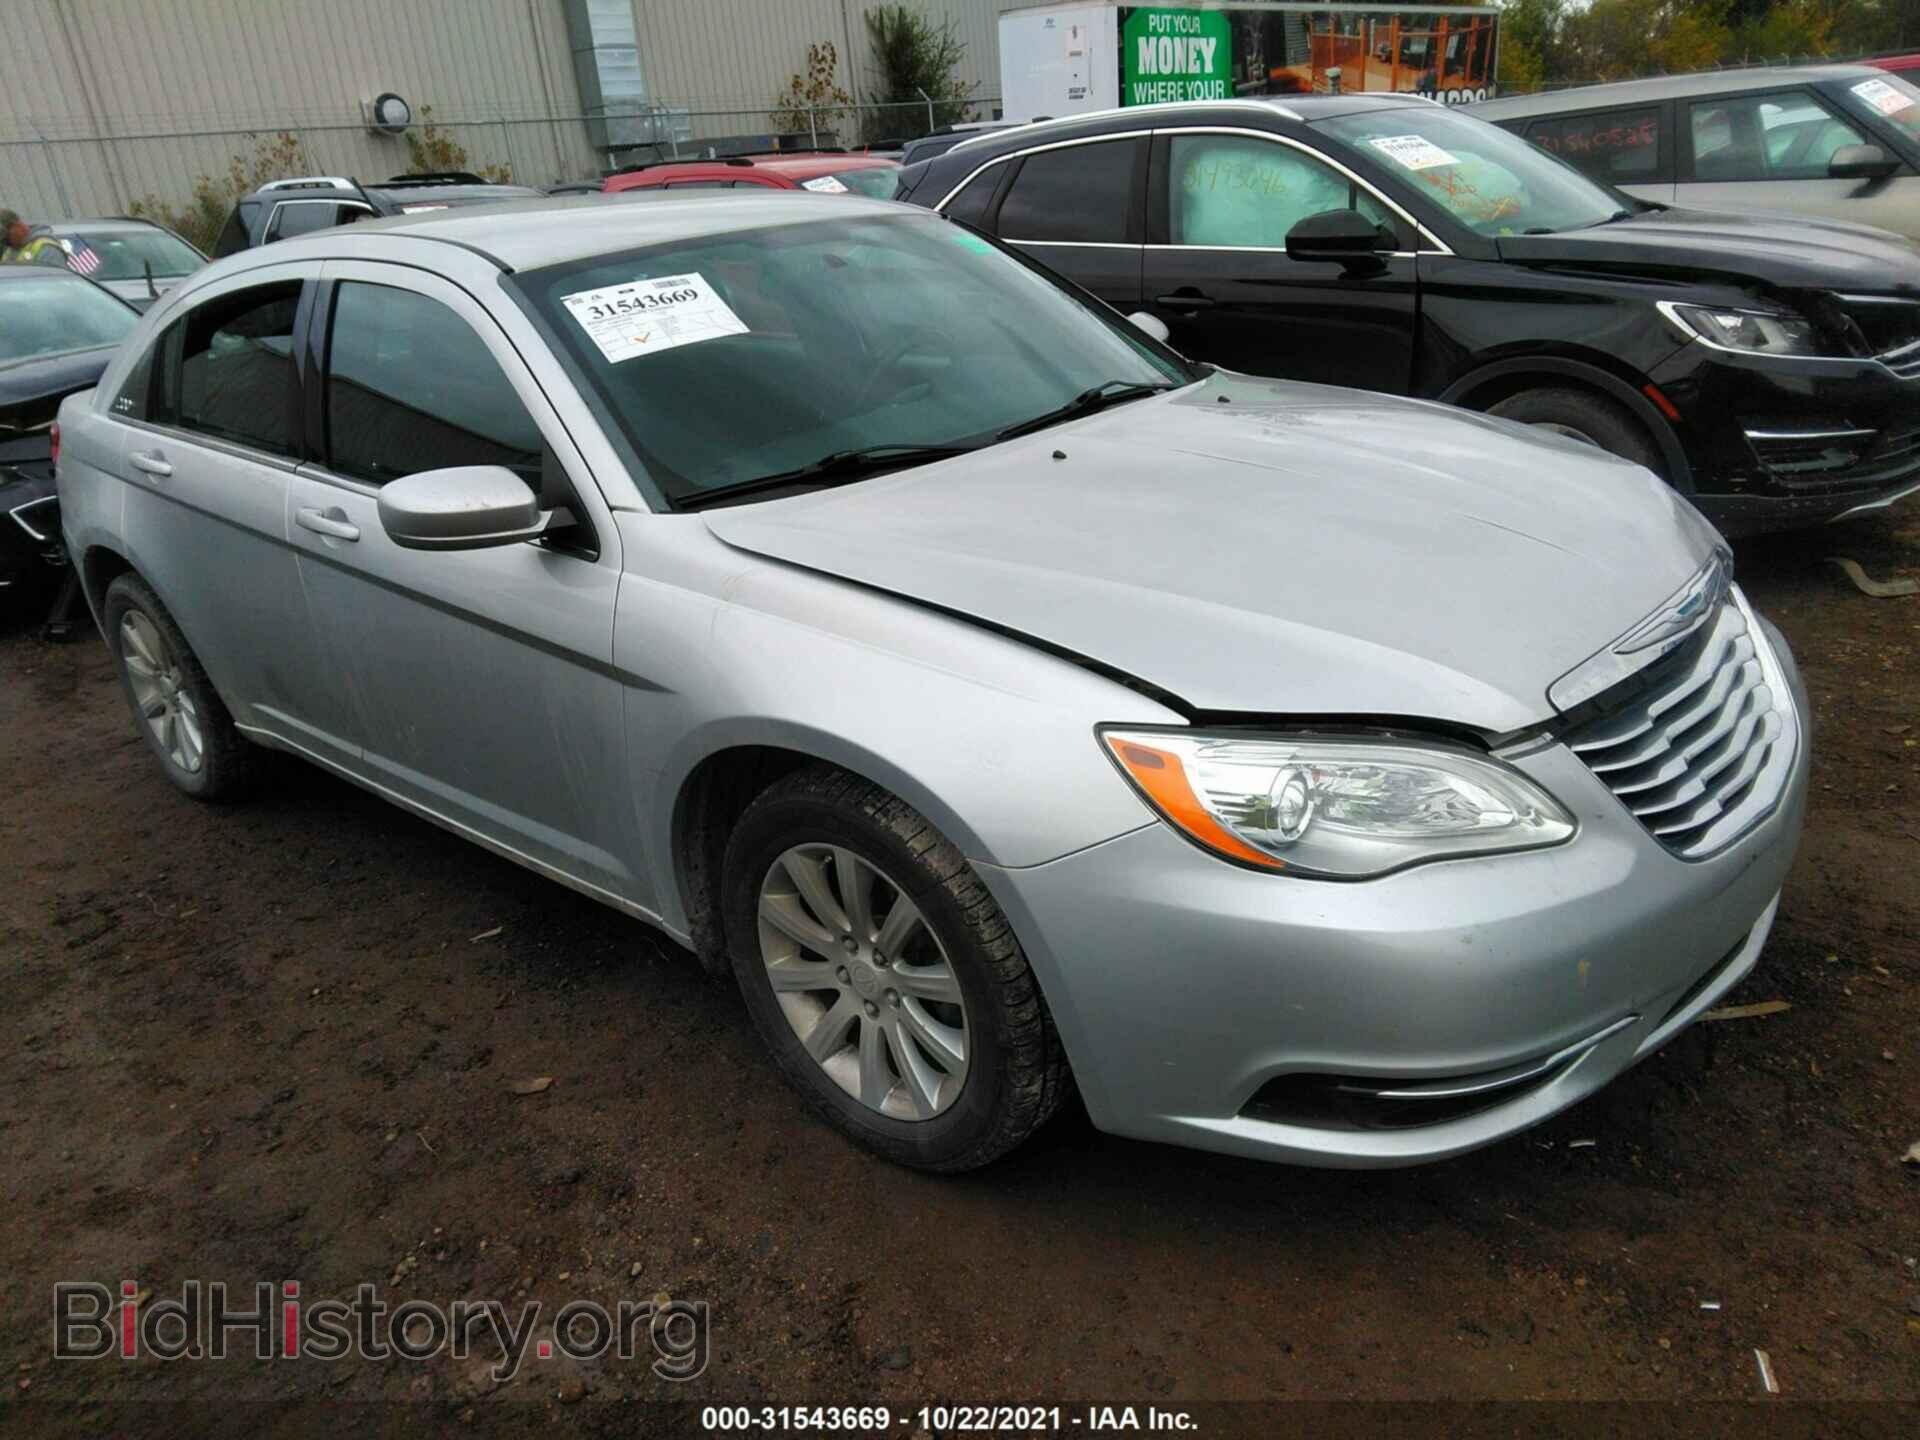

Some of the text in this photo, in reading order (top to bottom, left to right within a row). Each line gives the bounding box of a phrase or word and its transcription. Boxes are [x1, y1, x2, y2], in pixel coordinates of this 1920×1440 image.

[1148, 14, 1201, 34] PUT YOUR
[1137, 36, 1217, 75] MONEY
[1133, 80, 1225, 104] WHERE YOUR
[588, 288, 699, 320] 31543669
